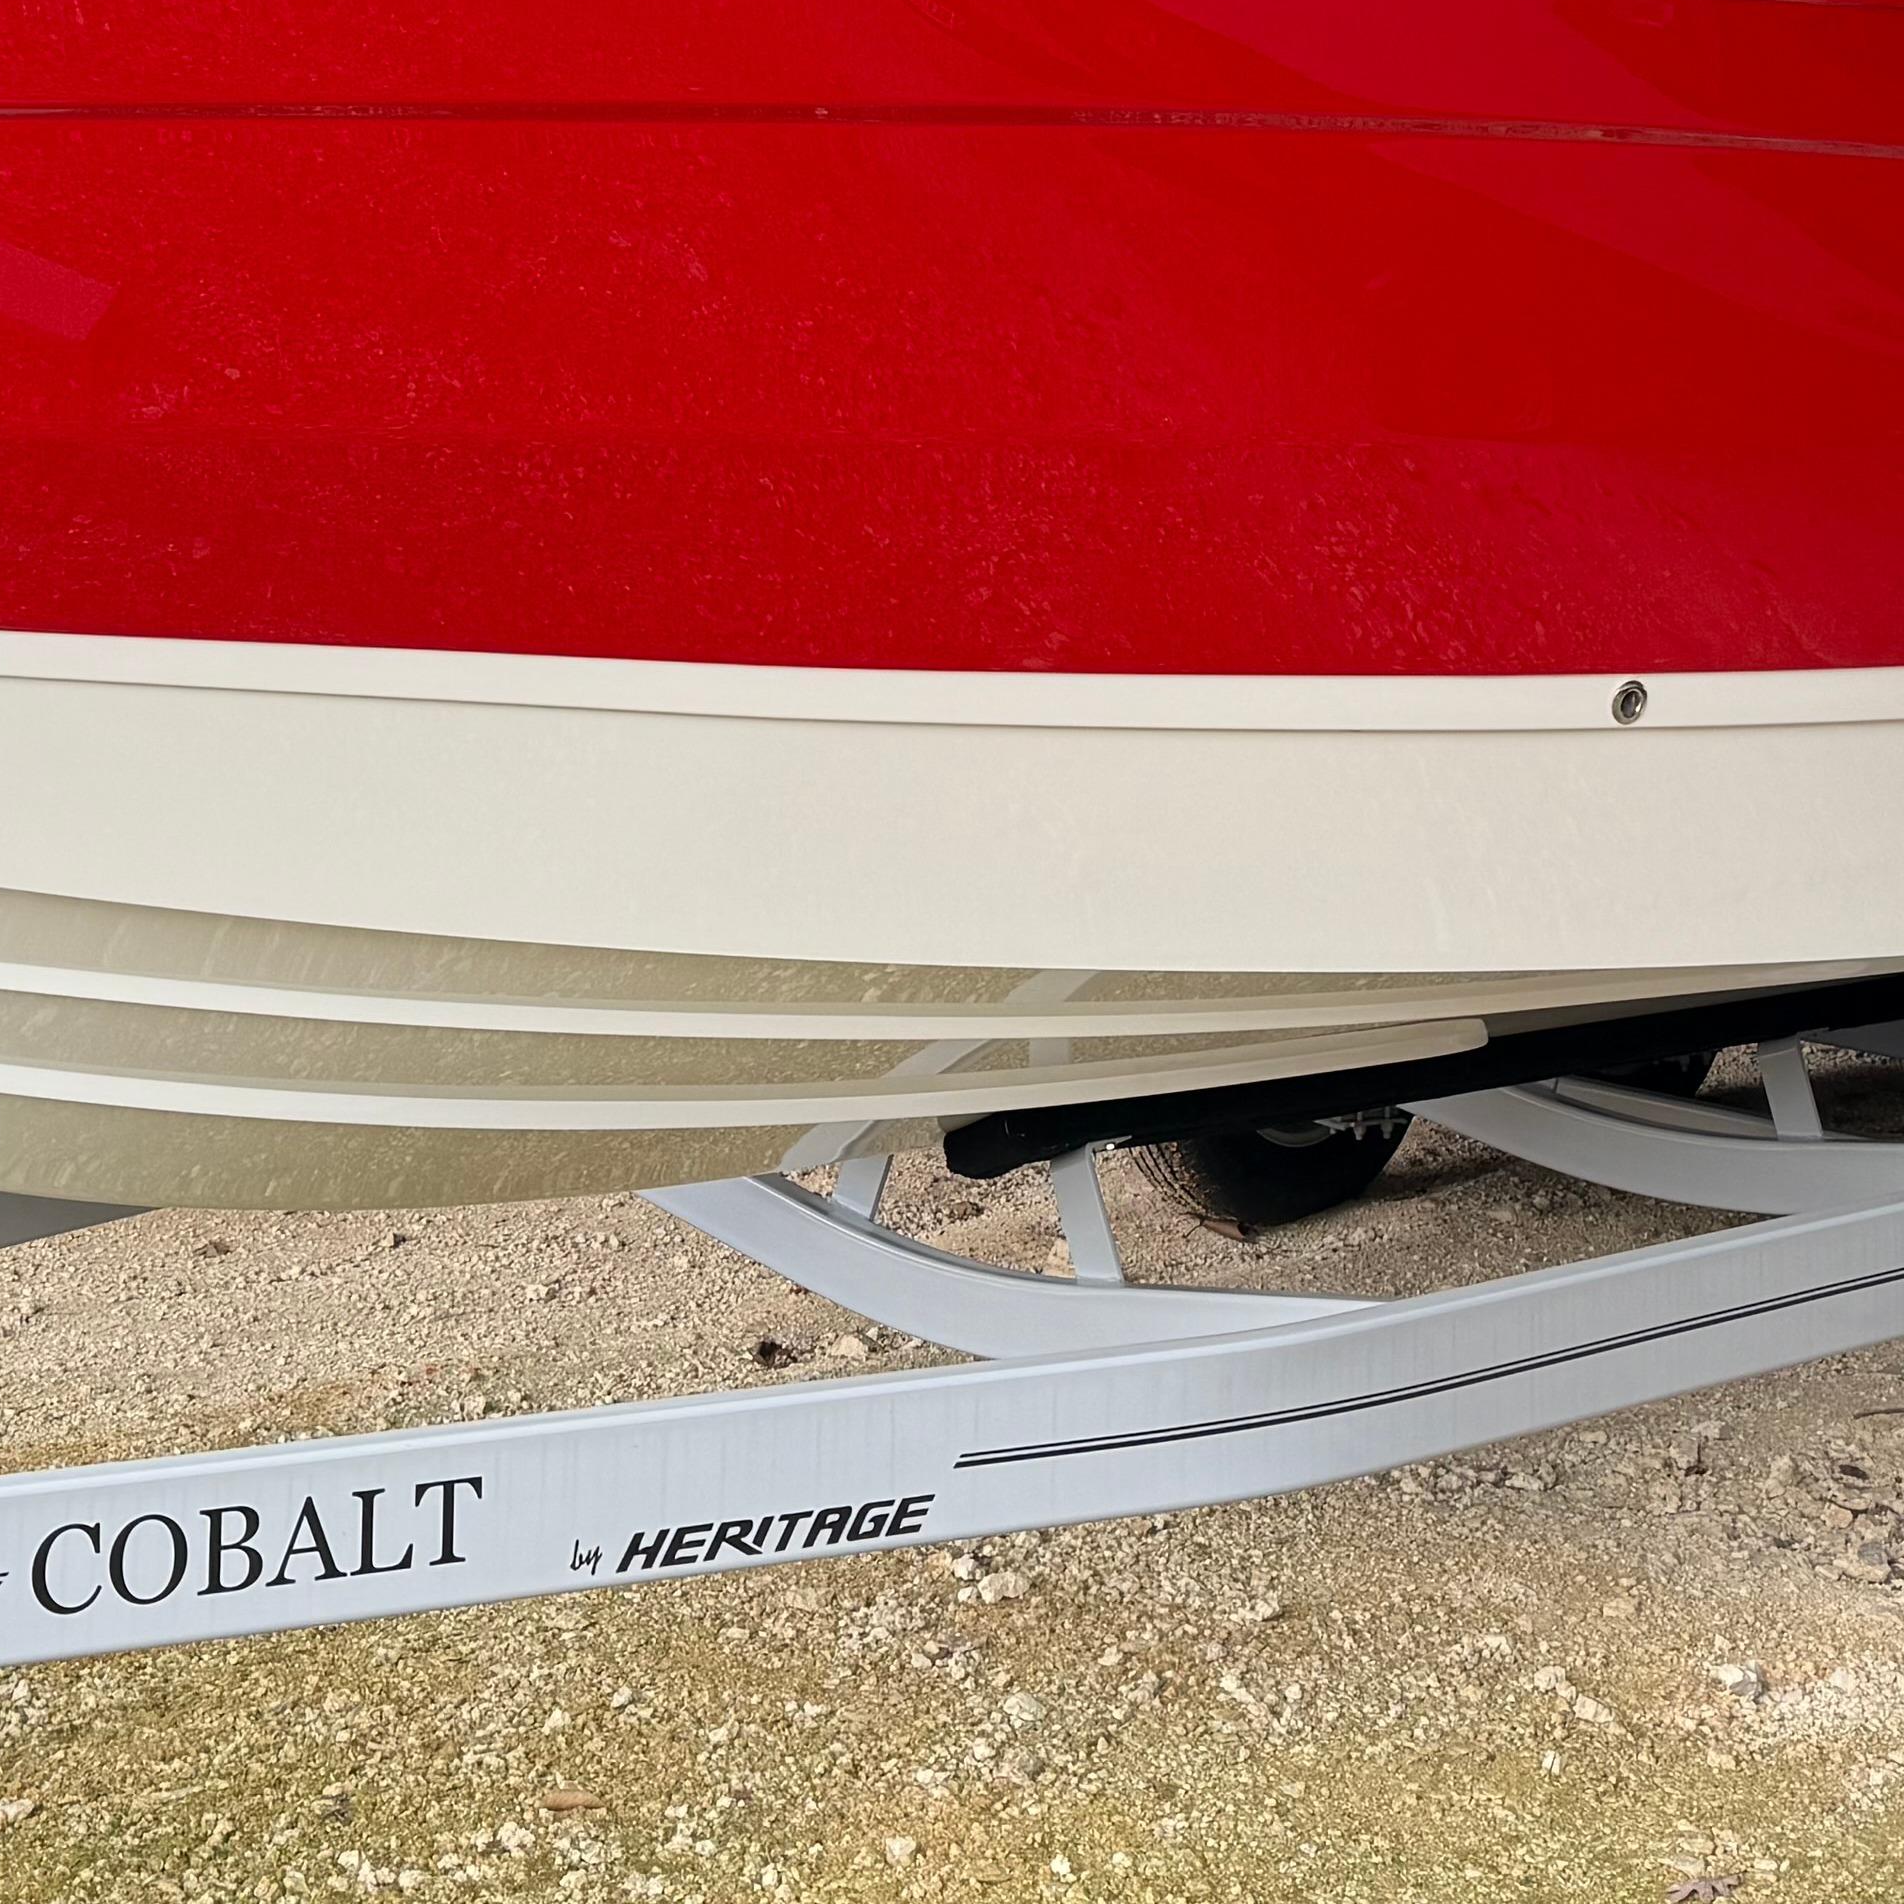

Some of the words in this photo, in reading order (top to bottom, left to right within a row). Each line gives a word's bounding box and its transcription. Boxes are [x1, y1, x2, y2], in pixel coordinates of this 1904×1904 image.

[31, 1476, 484, 1615] COBALT
[570, 1539, 603, 1575] by
[615, 1494, 936, 1574] HERITAGE
